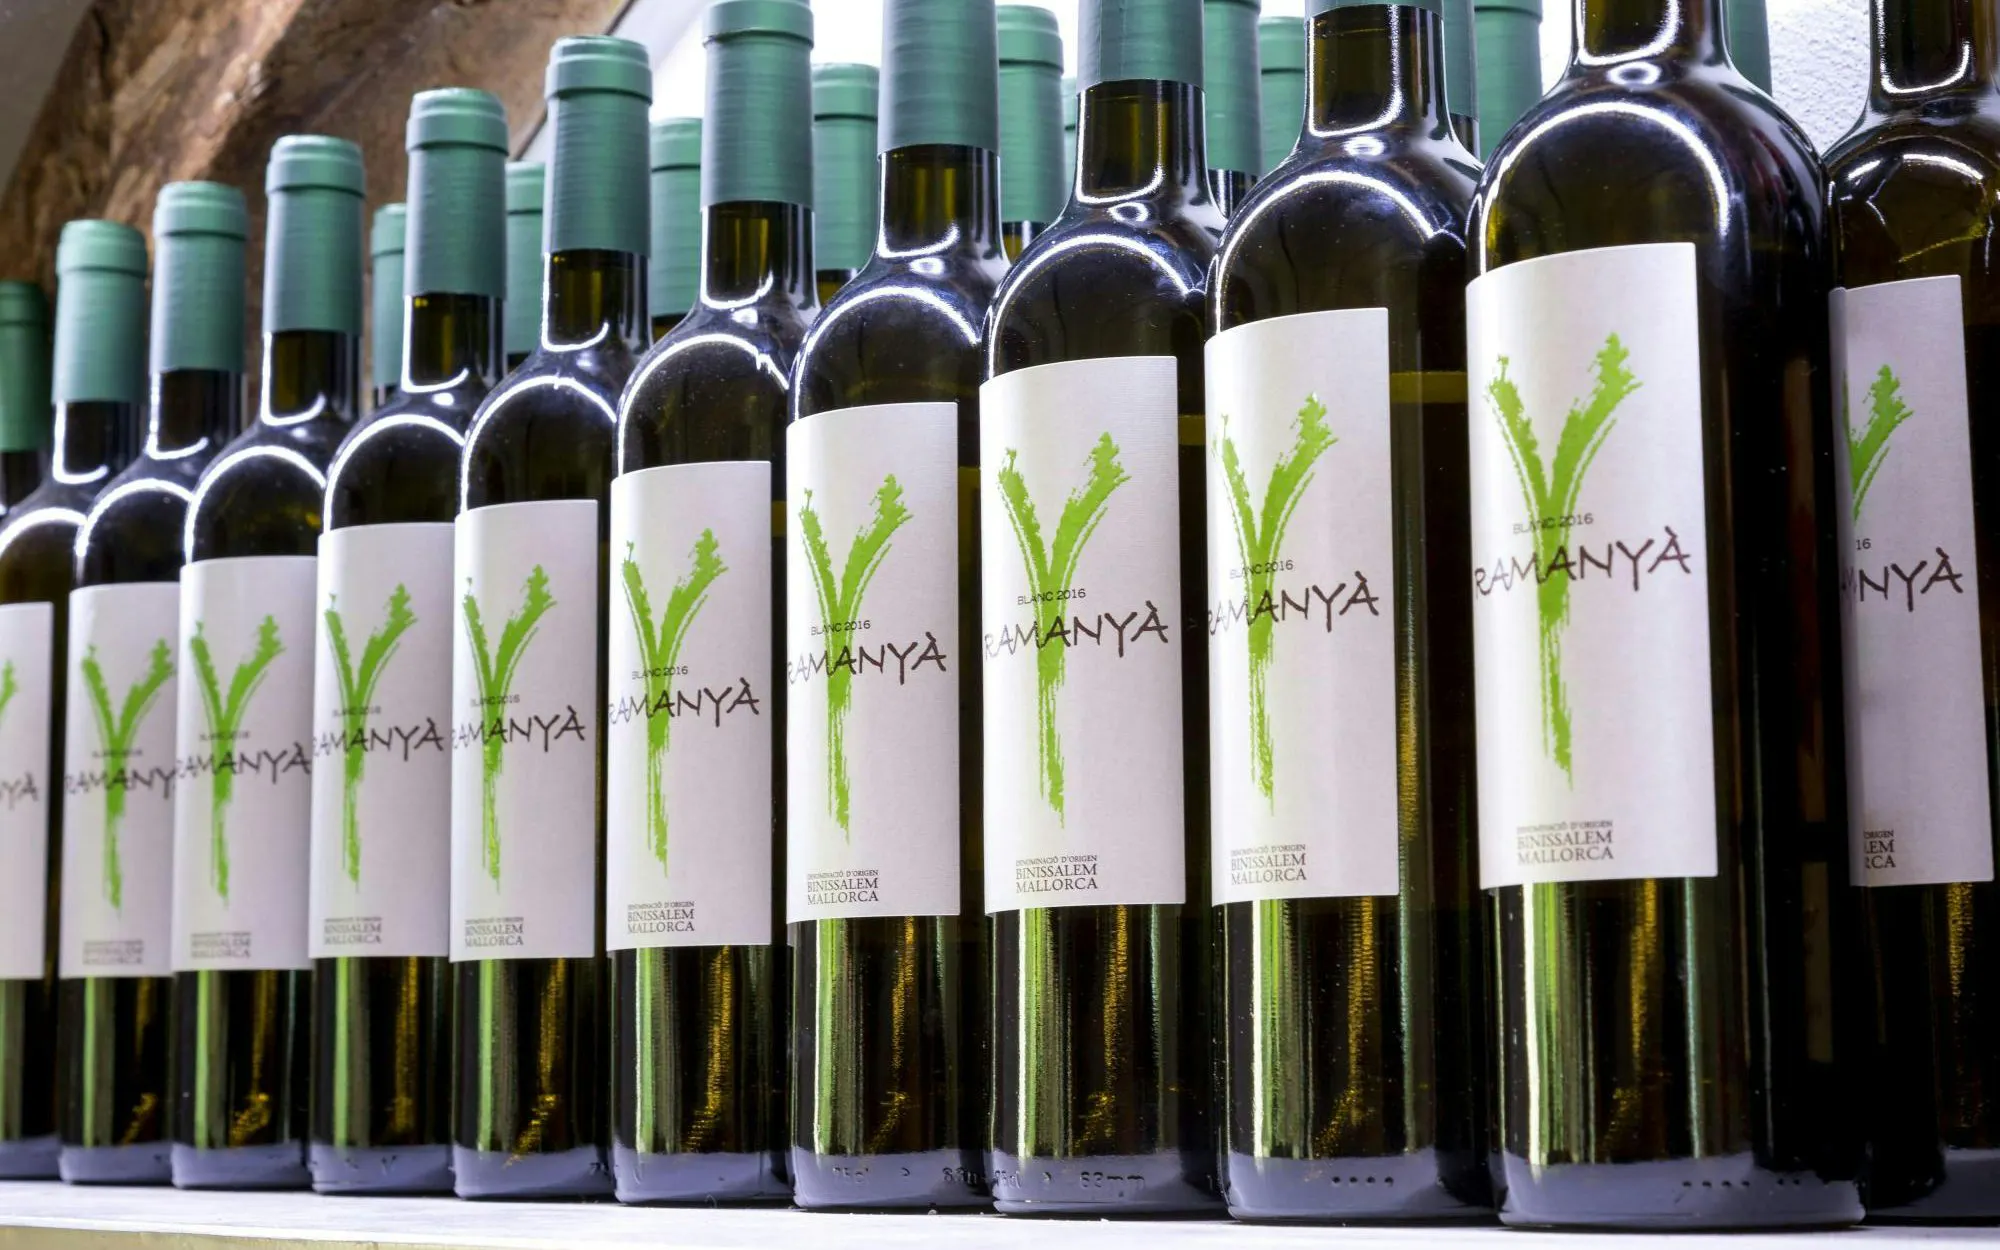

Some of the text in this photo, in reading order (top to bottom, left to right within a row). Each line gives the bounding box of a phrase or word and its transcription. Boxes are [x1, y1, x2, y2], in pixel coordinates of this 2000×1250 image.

[1513, 513, 1594, 534] BLANC 2016
[1265, 560, 1294, 573] 2016
[1475, 525, 1691, 597] RAMANYÀ
[1017, 588, 1087, 606] BLANC 2016
[844, 620, 871, 632] 2016
[984, 600, 1169, 661] RAMANYÀ
[664, 665, 689, 677] 2016
[1517, 830, 1613, 850] BINISSALEM
[1231, 853, 1306, 871] BINISSALEM
[1517, 846, 1614, 866] MALLORCA
[1016, 863, 1097, 880] BINISSALEM
[1231, 868, 1307, 886] MALLORCA
[807, 878, 878, 893] BINISSALEM
[1016, 878, 1098, 894] MALLORCA
[807, 890, 879, 906] MALLORCA
[627, 908, 695, 922] BINISSALEM
[627, 921, 695, 934] MALLORCA
